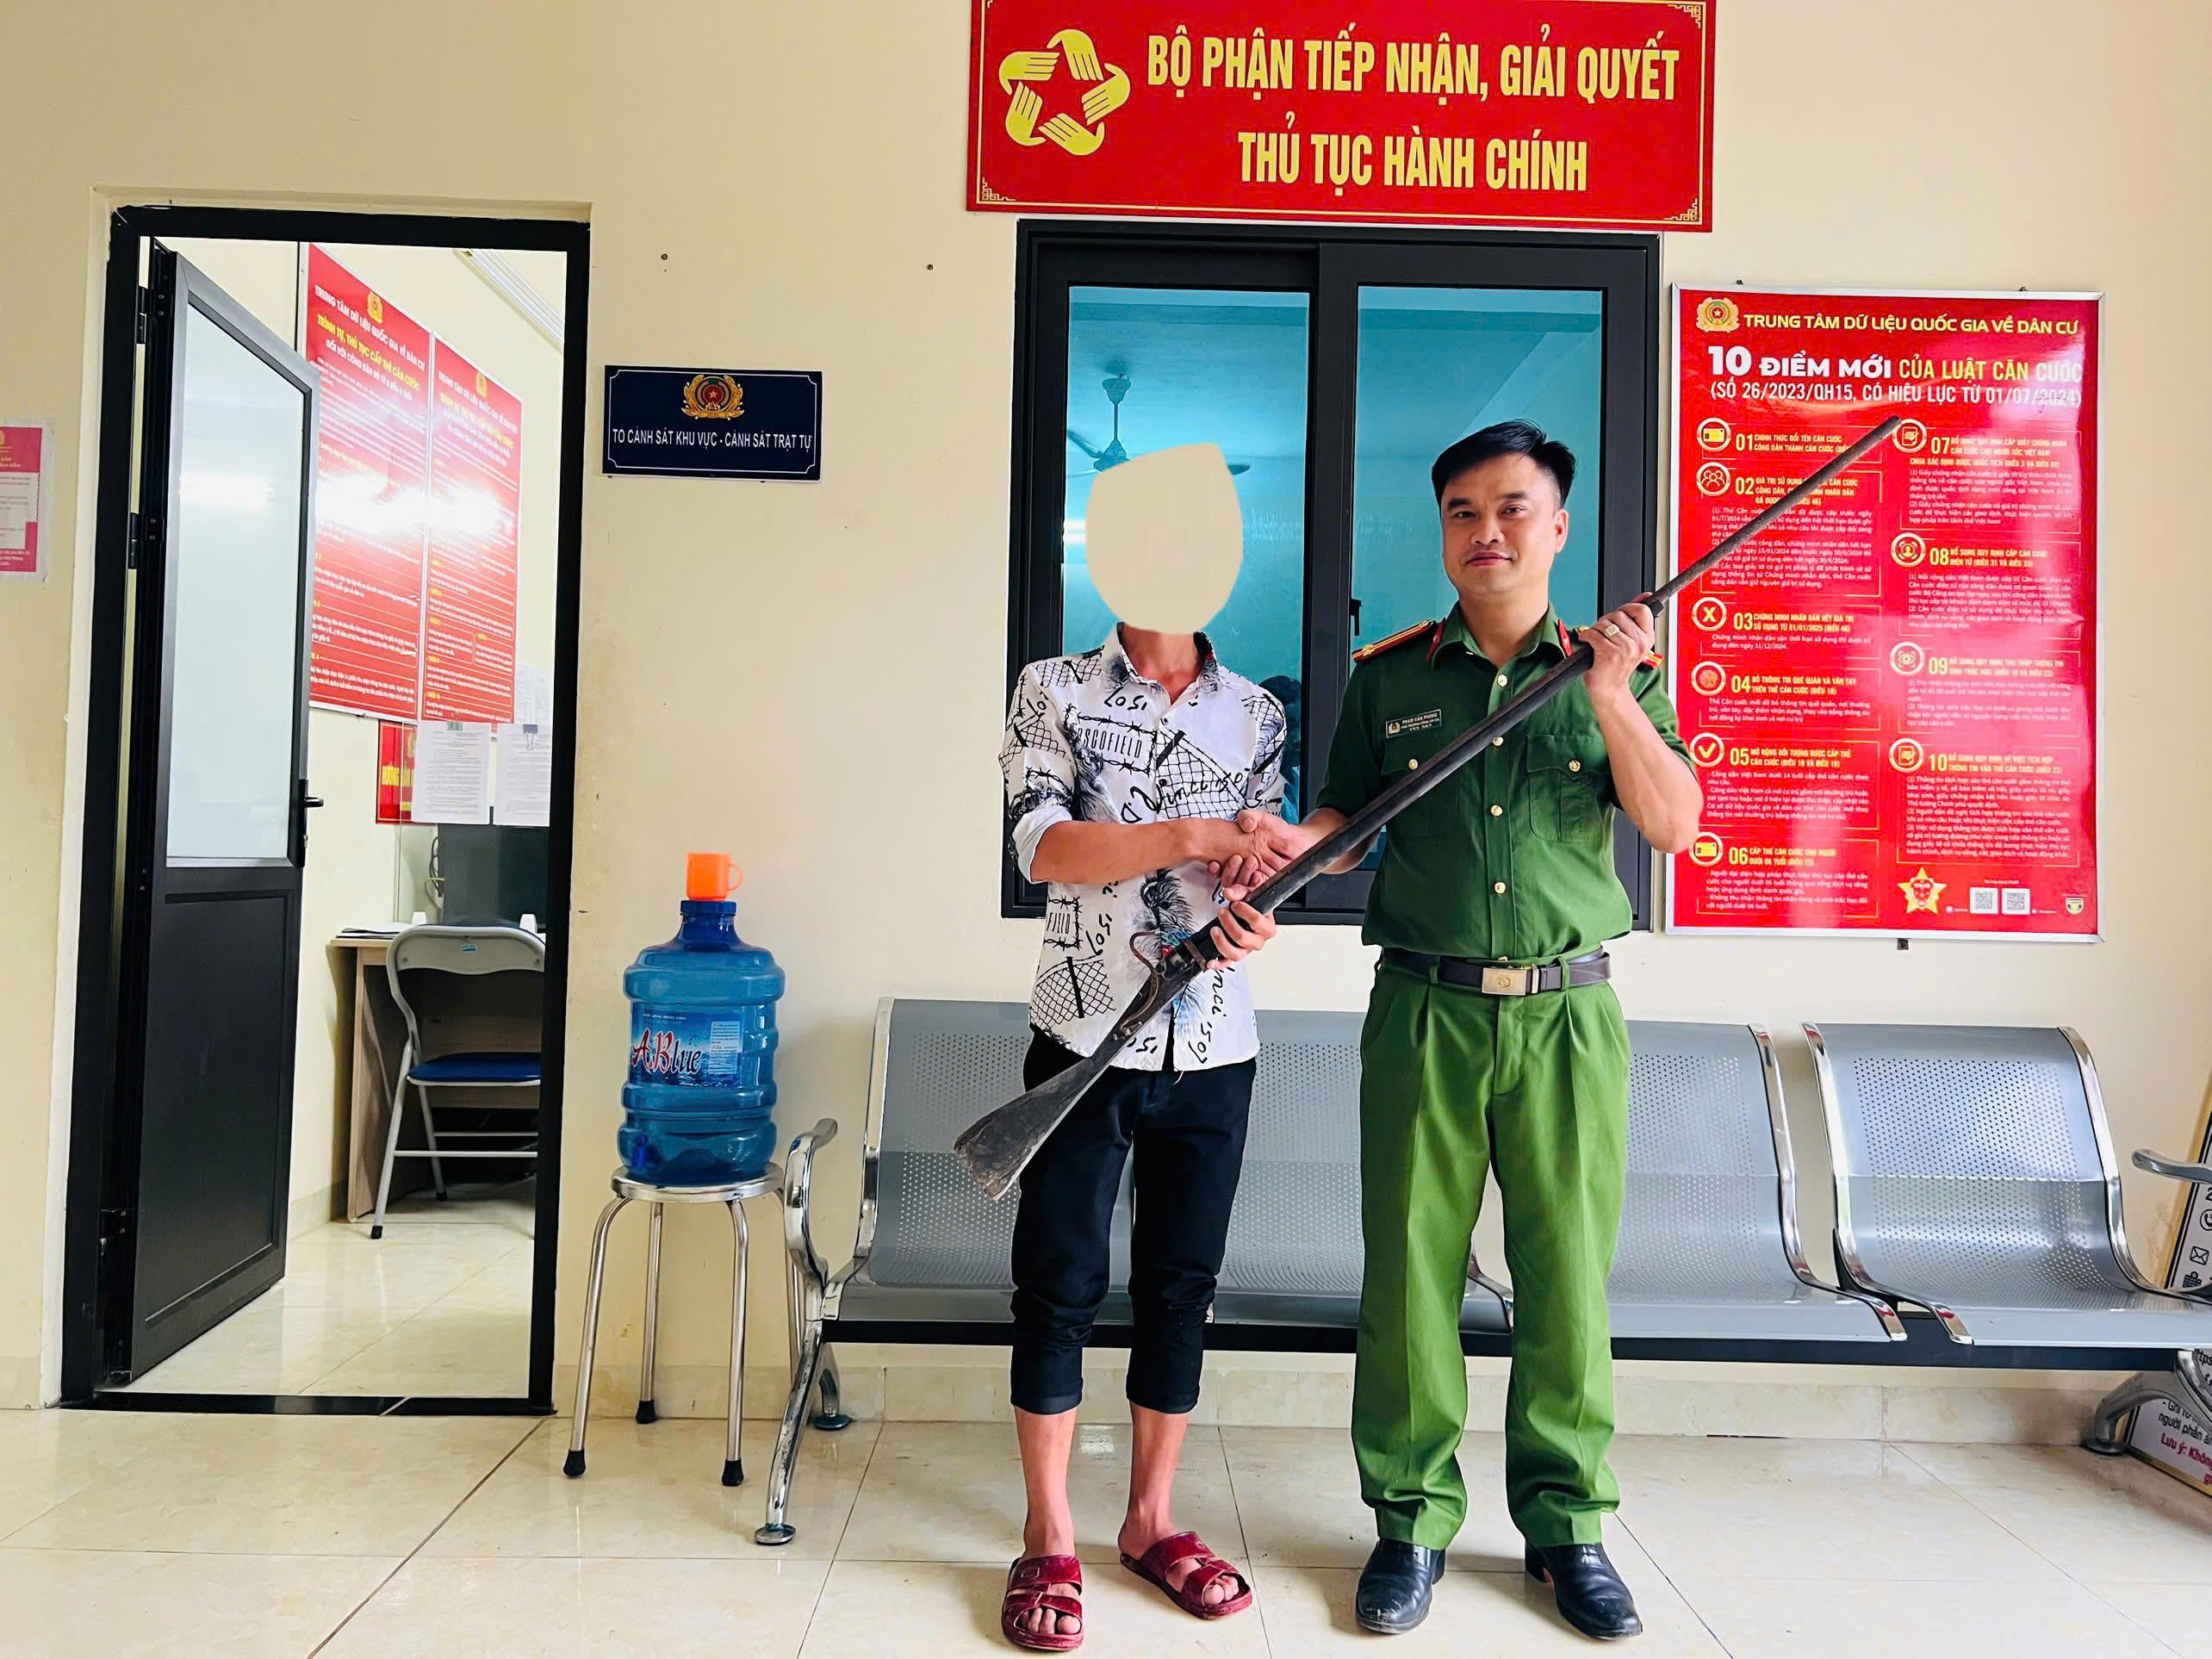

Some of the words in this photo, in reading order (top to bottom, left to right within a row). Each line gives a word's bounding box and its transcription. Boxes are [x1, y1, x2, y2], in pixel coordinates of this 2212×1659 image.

[1148, 25, 1190, 99] BỘ
[1203, 29, 1293, 102] PHẬN
[1305, 23, 1376, 96] TIẾP
[1387, 33, 1488, 105] NHẬN,
[1501, 23, 1566, 99] GIẢI
[1578, 31, 1680, 105] QUYẾT
[1239, 111, 1301, 183] THỦ
[1311, 134, 1373, 197] TỤC
[1384, 124, 1476, 189] HÀNH
[1486, 128, 1588, 192] CHÍNH
[1743, 314, 1801, 328] TRUNG
[1804, 313, 1839, 329] TÂM
[1844, 314, 1867, 330] DỮ
[1871, 314, 1906, 332] LIỆU
[1911, 314, 1957, 331] QUỐC
[1960, 319, 1989, 332] GIA
[1991, 315, 2014, 332] VỀ
[2017, 318, 2052, 334] DÂN
[2055, 320, 2078, 335] CƯ
[1708, 345, 1752, 376] 10
[1759, 351, 1830, 377] ĐIỂM
[1839, 353, 1892, 378] MỚI
[1899, 353, 1935, 379] CỦA
[1942, 357, 1986, 383] LUẬT
[1992, 359, 2029, 381] CĂN
[1710, 376, 1737, 401] (SỐ
[1742, 382, 1856, 402] 26/2023/QH15,
[1862, 382, 1882, 401] CÓ
[1888, 382, 1922, 404] HIỆU
[1927, 384, 1956, 405] LỰC
[1961, 383, 1980, 403] TỪ
[656, 427, 674, 445] SÁT
[676, 431, 695, 446] KHU
[698, 432, 717, 450] VỰC
[753, 430, 771, 448] SÁT
[799, 434, 812, 452] TỰ
[1736, 433, 1753, 450] 01
[1930, 437, 1951, 454] 07
[1735, 476, 1754, 494] 02
[1929, 547, 1949, 566] 08
[1733, 612, 1753, 630] 03
[1929, 657, 1948, 675] 09
[1731, 675, 1750, 693] 04
[1730, 748, 1749, 766] 05
[1929, 754, 1948, 772] 10
[1729, 847, 1749, 866] 06
[2159, 1414, 2182, 1430] người
[2182, 1424, 2203, 1441] phản
[2161, 1432, 2177, 1450] Lưu
